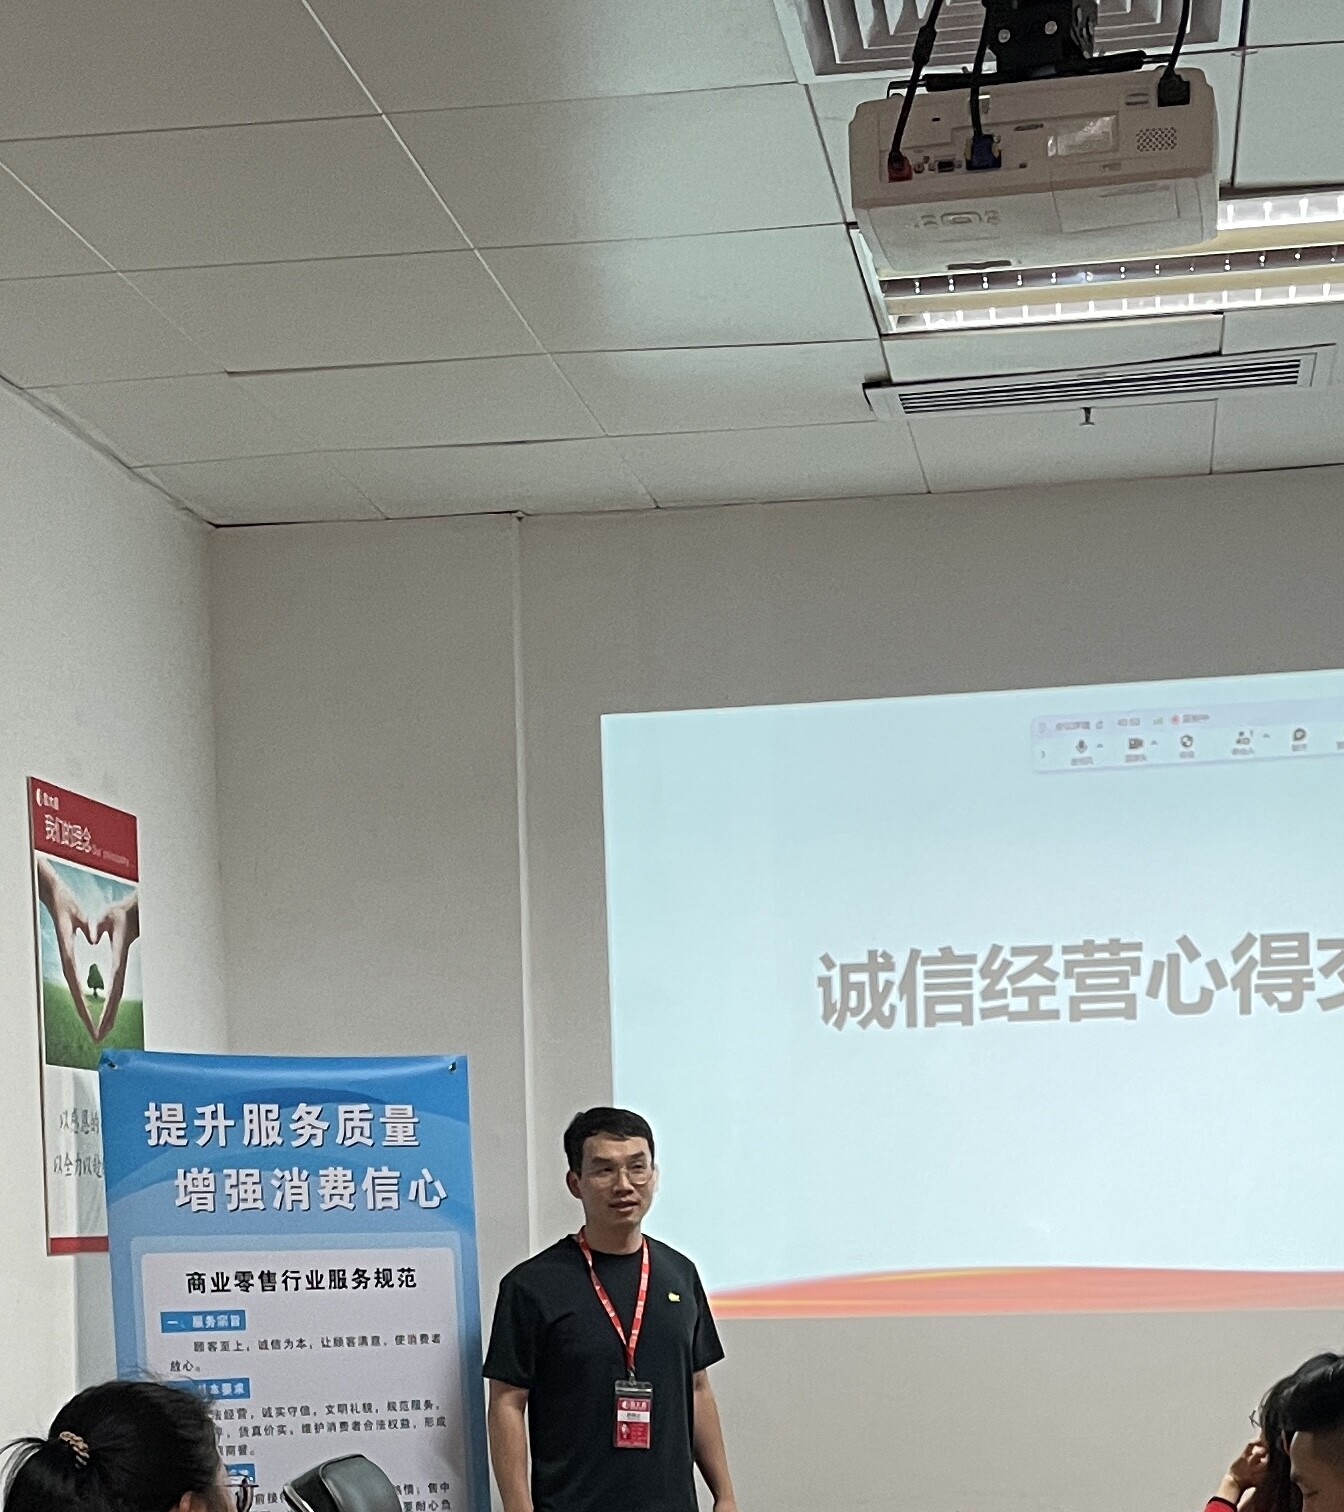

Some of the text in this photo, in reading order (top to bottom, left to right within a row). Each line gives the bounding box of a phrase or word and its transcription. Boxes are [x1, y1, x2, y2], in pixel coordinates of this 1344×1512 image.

[144, 1101, 421, 1148] 提升服务质量
[173, 1165, 448, 1213] 增强消费信心
[185, 1266, 418, 1295] 商业零售行业服务规范
